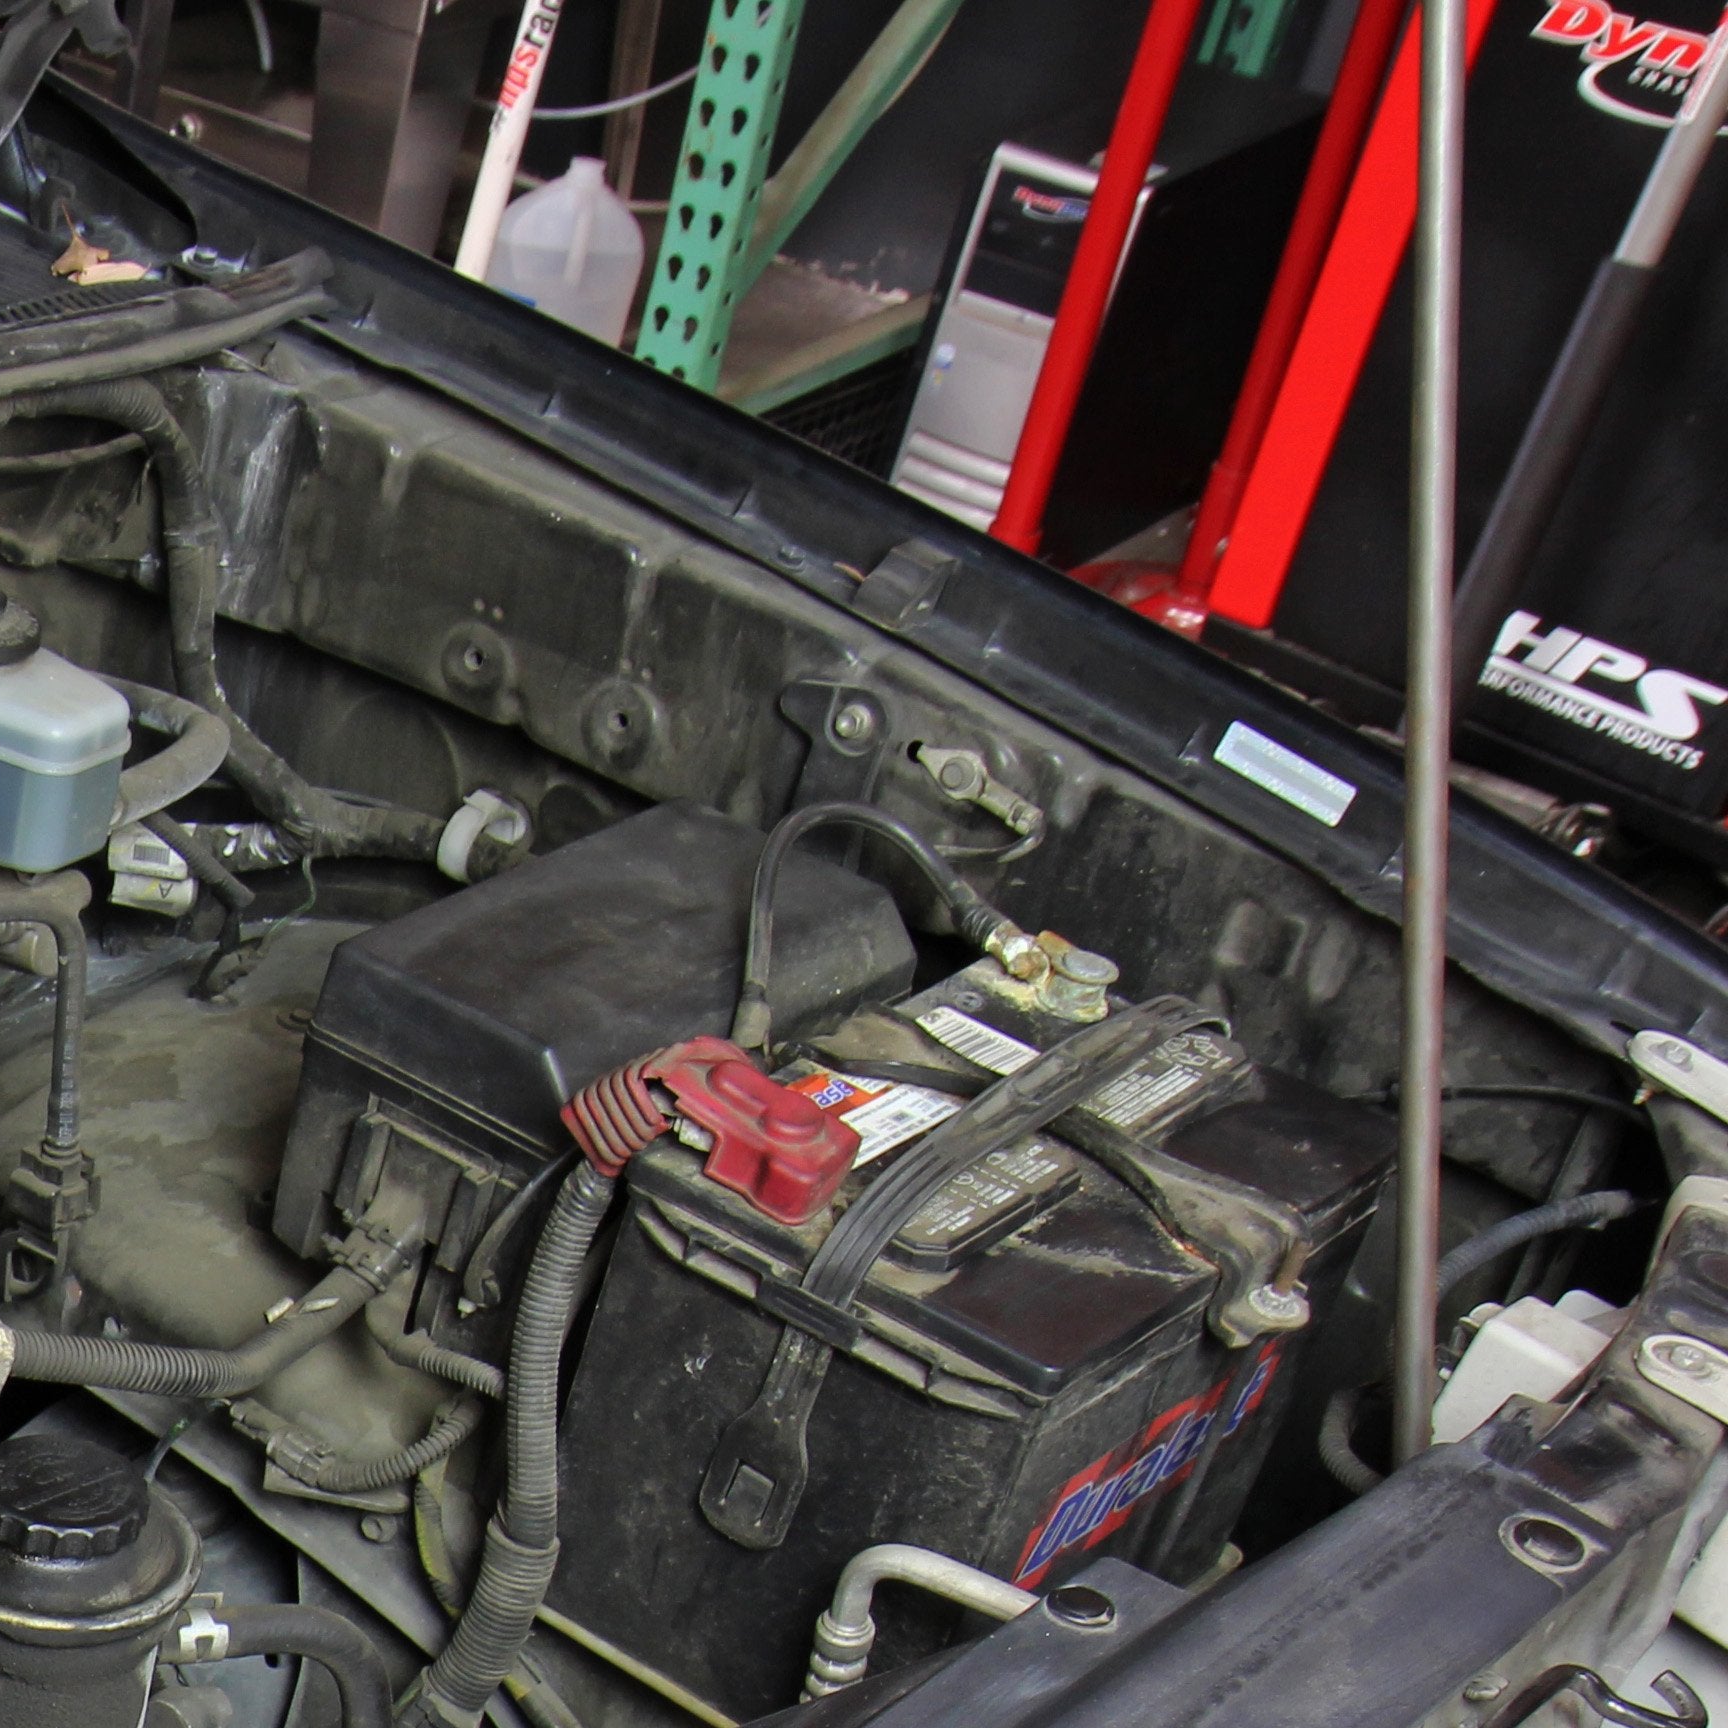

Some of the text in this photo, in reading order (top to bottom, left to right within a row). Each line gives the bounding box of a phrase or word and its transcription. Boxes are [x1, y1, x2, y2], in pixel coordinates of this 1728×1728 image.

[1530, 0, 1711, 77] Dyn
[1486, 609, 1728, 740] HPS
[1595, 715, 1704, 769] PRODUCTS
[1016, 1356, 1275, 1582] Duralat
